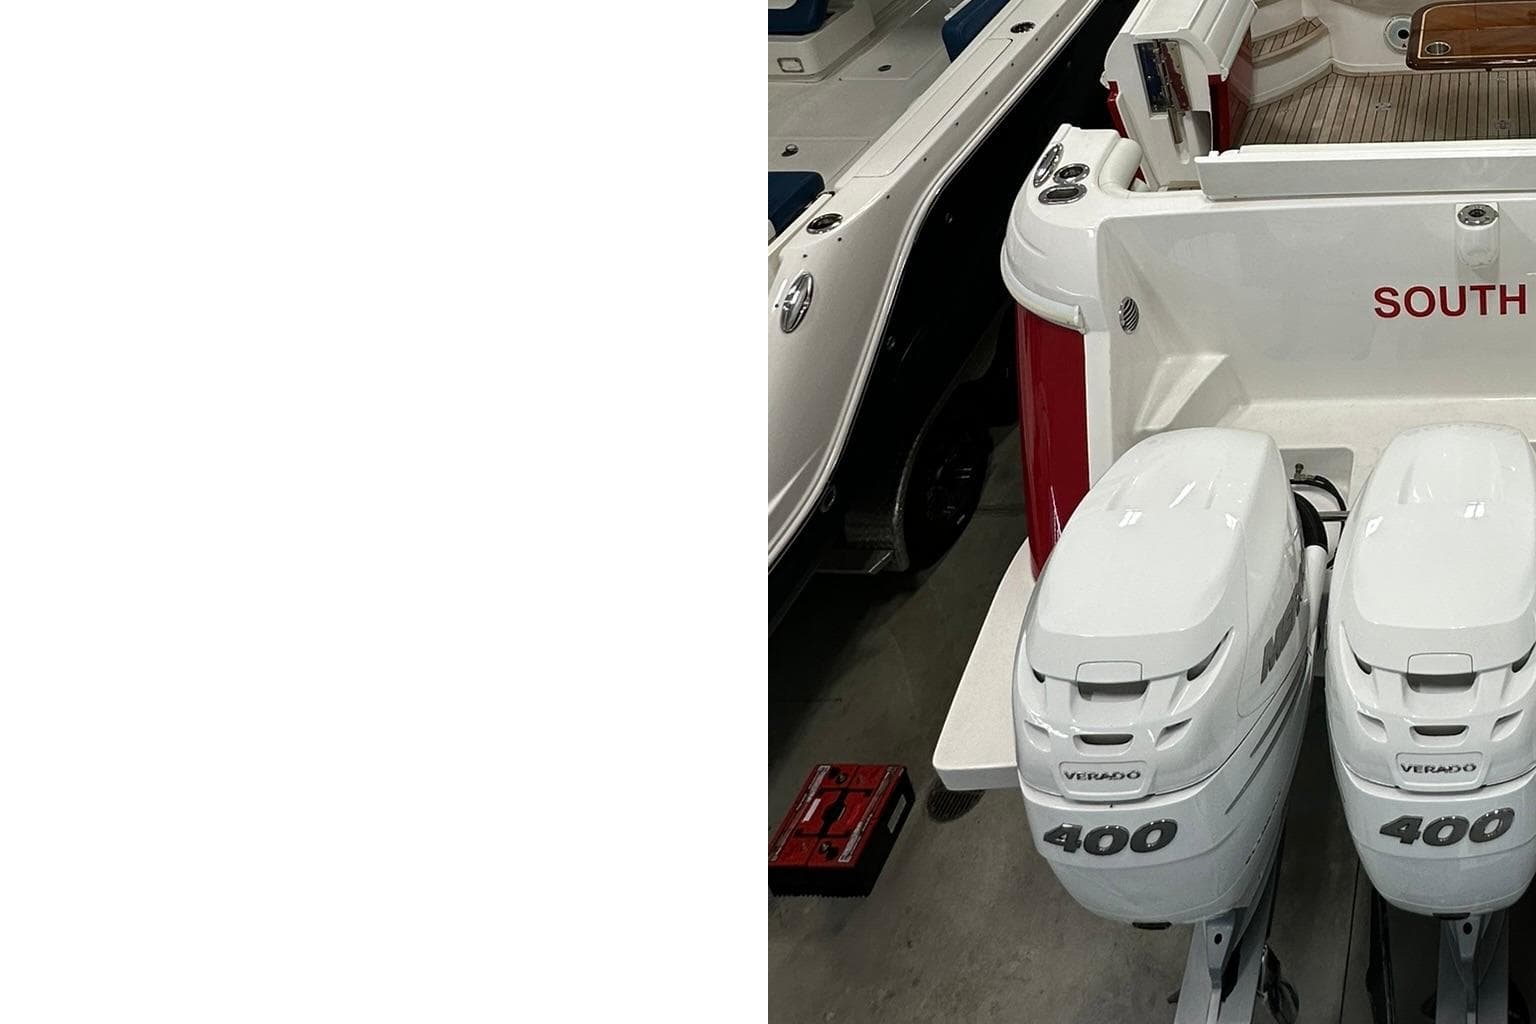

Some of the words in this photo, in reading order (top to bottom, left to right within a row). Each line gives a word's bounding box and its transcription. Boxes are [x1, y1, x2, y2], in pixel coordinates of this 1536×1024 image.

[1374, 283, 1527, 318] SOUTH
[1064, 770, 1141, 781] VERADO
[1400, 763, 1477, 774] VERADO
[1043, 818, 1178, 856] 400
[1379, 807, 1516, 847] 400
